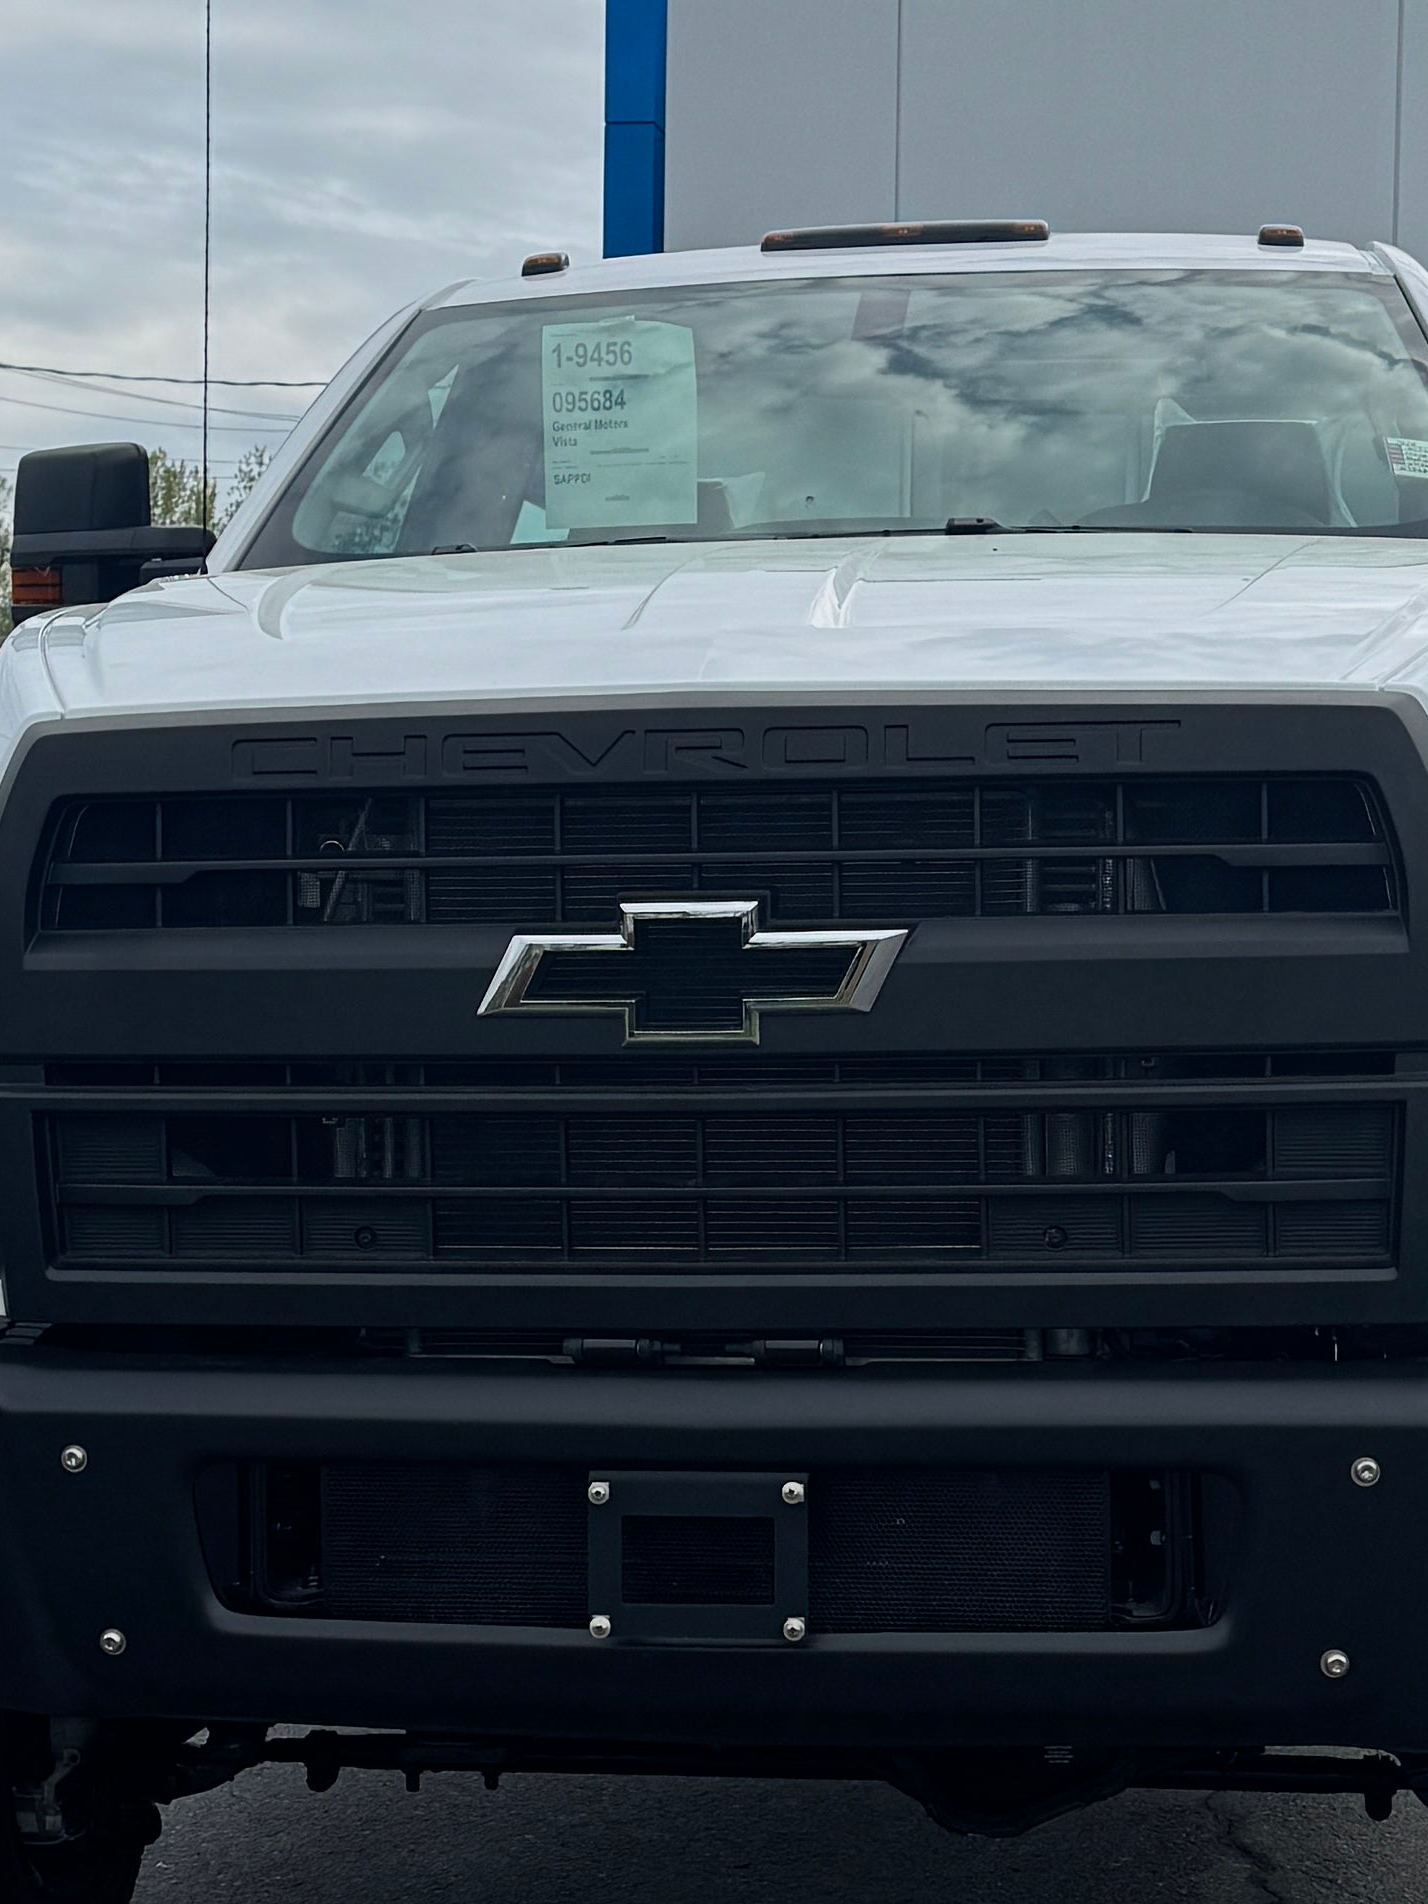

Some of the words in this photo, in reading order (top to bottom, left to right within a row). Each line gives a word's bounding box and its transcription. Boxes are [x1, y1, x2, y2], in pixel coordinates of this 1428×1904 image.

[551, 341, 632, 368] 1-9456
[552, 389, 626, 413] 095684
[552, 420, 591, 432] General
[594, 419, 628, 430] Motors
[231, 719, 1182, 781] CHEVROLET
